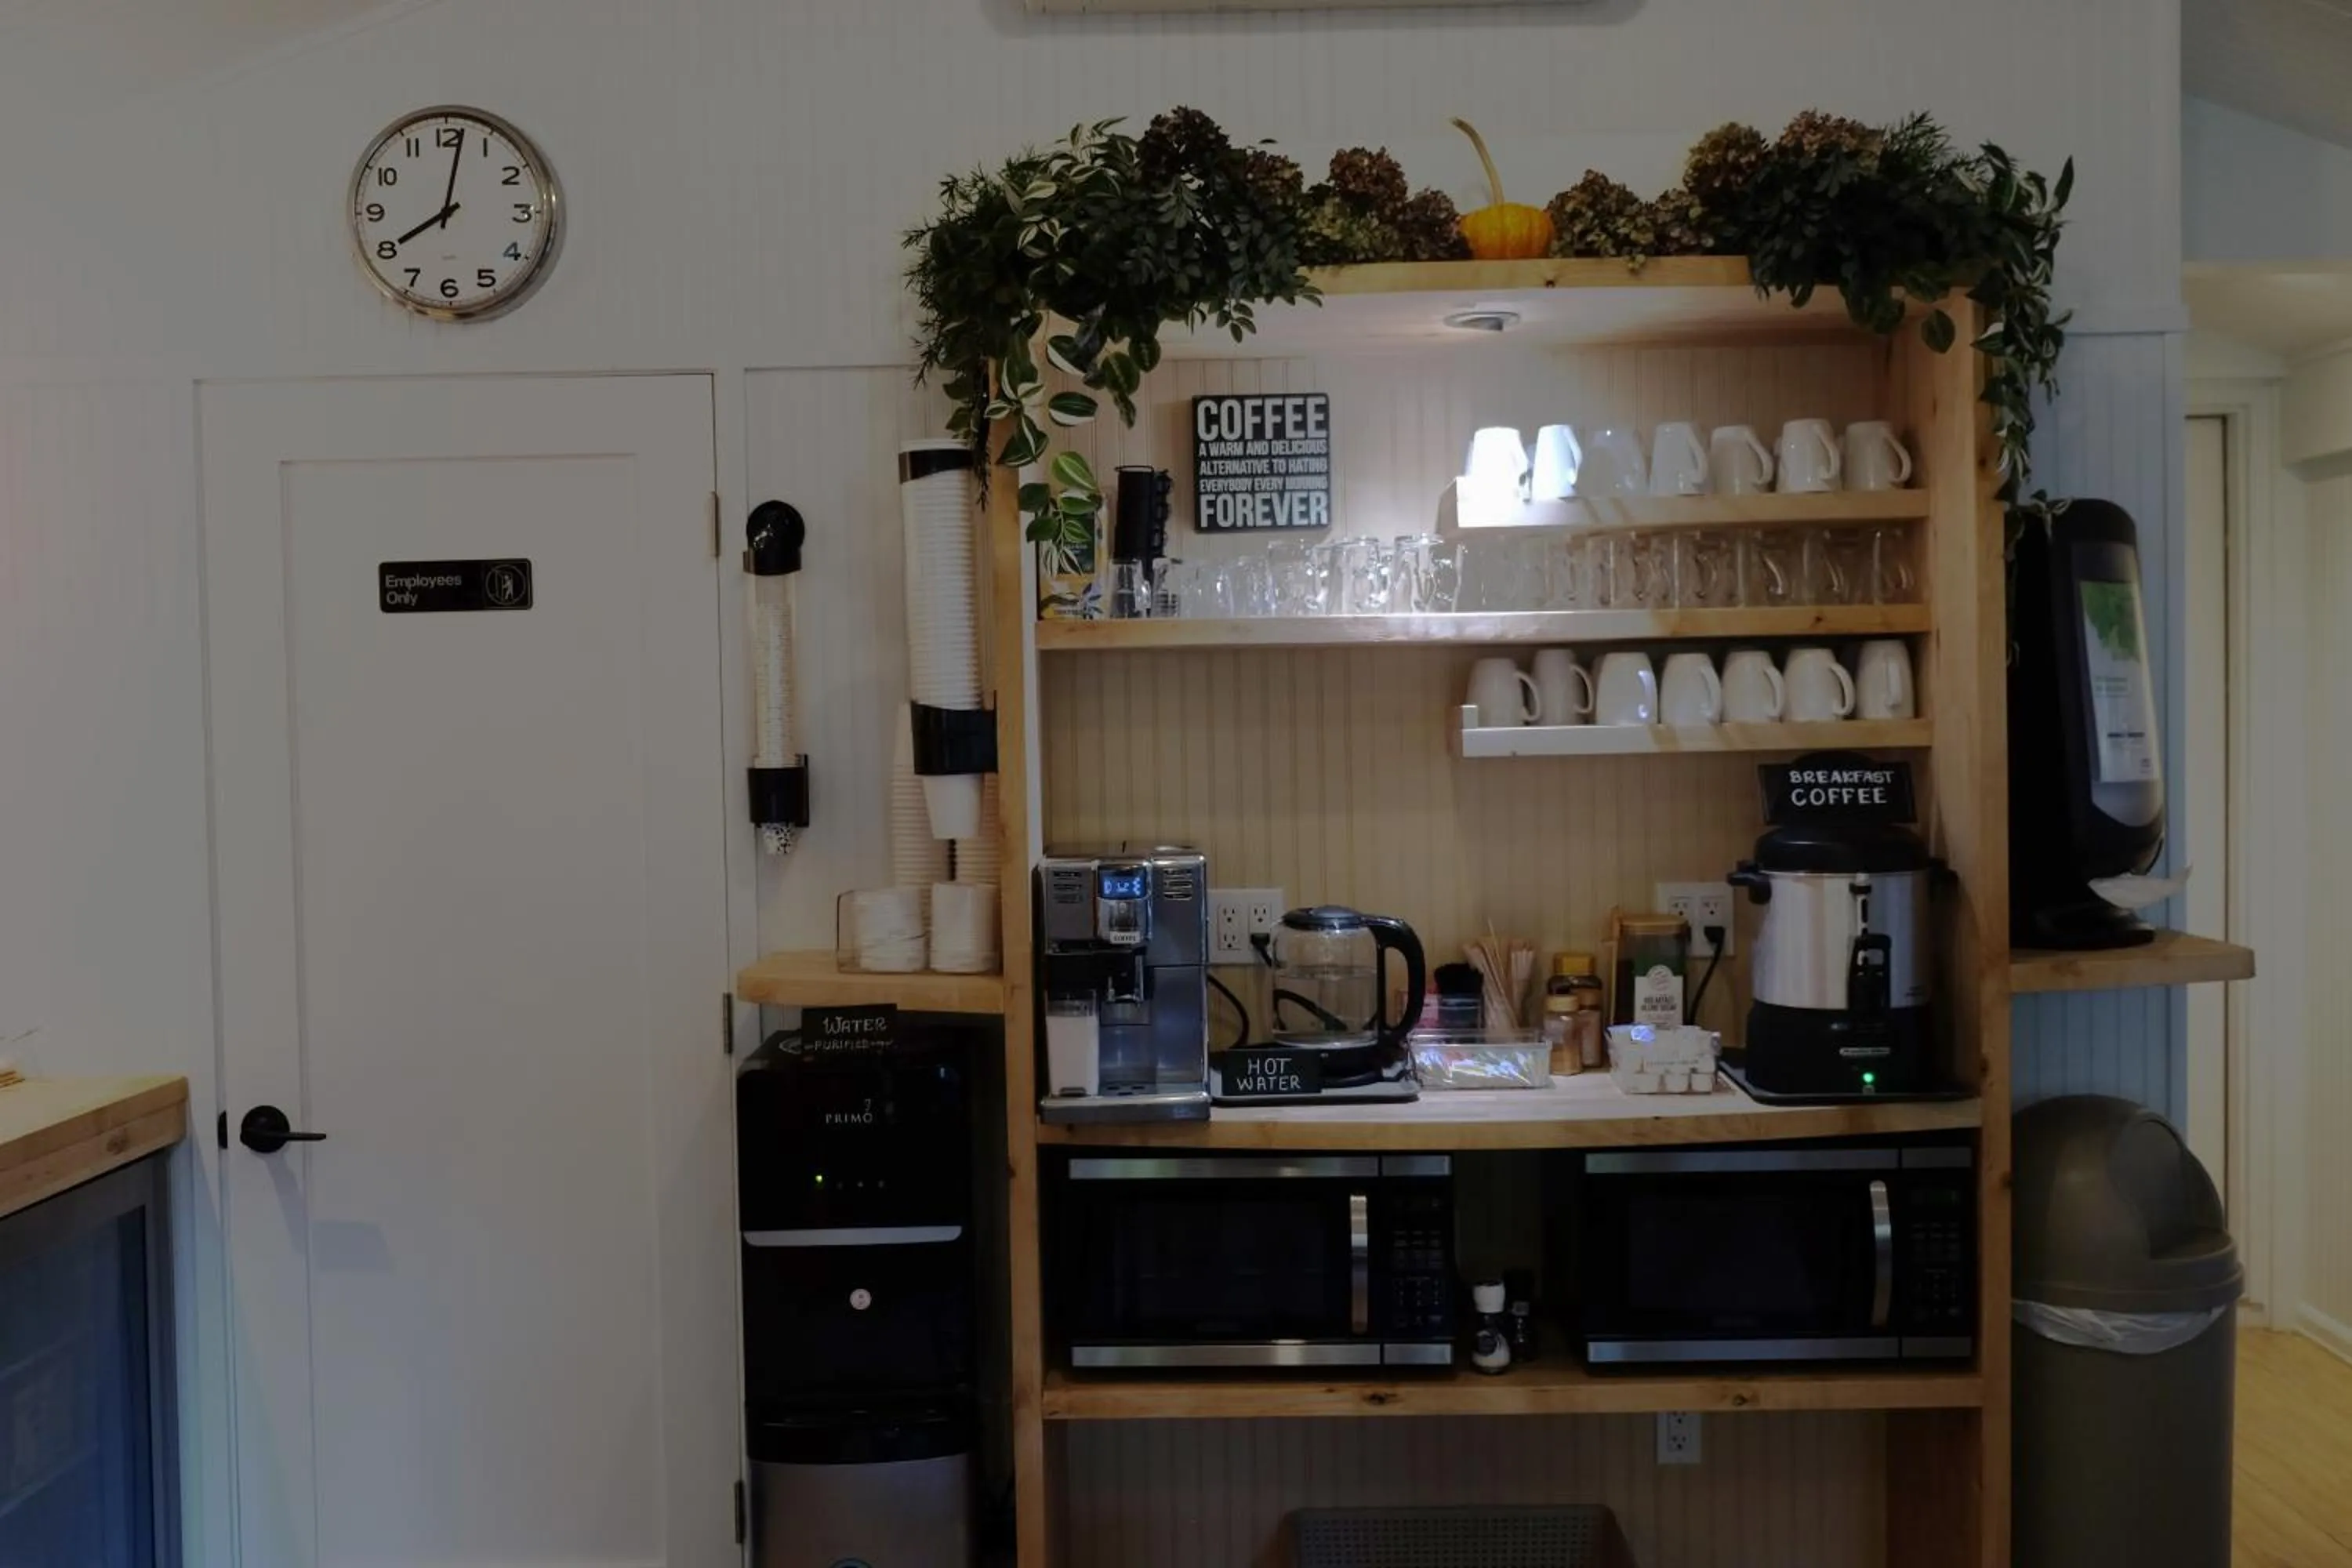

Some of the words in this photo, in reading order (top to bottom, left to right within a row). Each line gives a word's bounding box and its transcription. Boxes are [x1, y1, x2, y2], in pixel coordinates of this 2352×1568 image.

[406, 137, 419, 158] 11
[437, 129, 461, 147] 12
[483, 137, 488, 158] 1
[378, 167, 397, 187] 10
[501, 166, 521, 186] 2
[365, 203, 385, 223] 9
[512, 203, 532, 223] 3
[376, 240, 397, 260] 8
[502, 241, 521, 261] 4
[404, 267, 421, 287] 7
[477, 269, 496, 288] 5
[440, 278, 459, 298] 6
[1196, 396, 1328, 441] COFFEE
[1199, 442, 1207, 456] A
[1208, 441, 1244, 456] WARM
[1246, 440, 1269, 456] AND
[1271, 439, 1327, 455] DELICIOUS
[1200, 458, 1270, 475] ALTERNATIVE
[1272, 458, 1287, 474] TO
[1200, 477, 1253, 493] EVERYBODY
[1254, 476, 1284, 491] EVERY
[1200, 491, 1328, 528] FOREVER
[385, 573, 463, 590] Employees
[386, 590, 419, 607] Only
[1788, 769, 1895, 785] BREAKFAST
[1790, 786, 1888, 807] COFFEE
[822, 1016, 888, 1035] WATER
[1247, 1057, 1293, 1075] HOT
[1236, 1074, 1301, 1091] WATER
